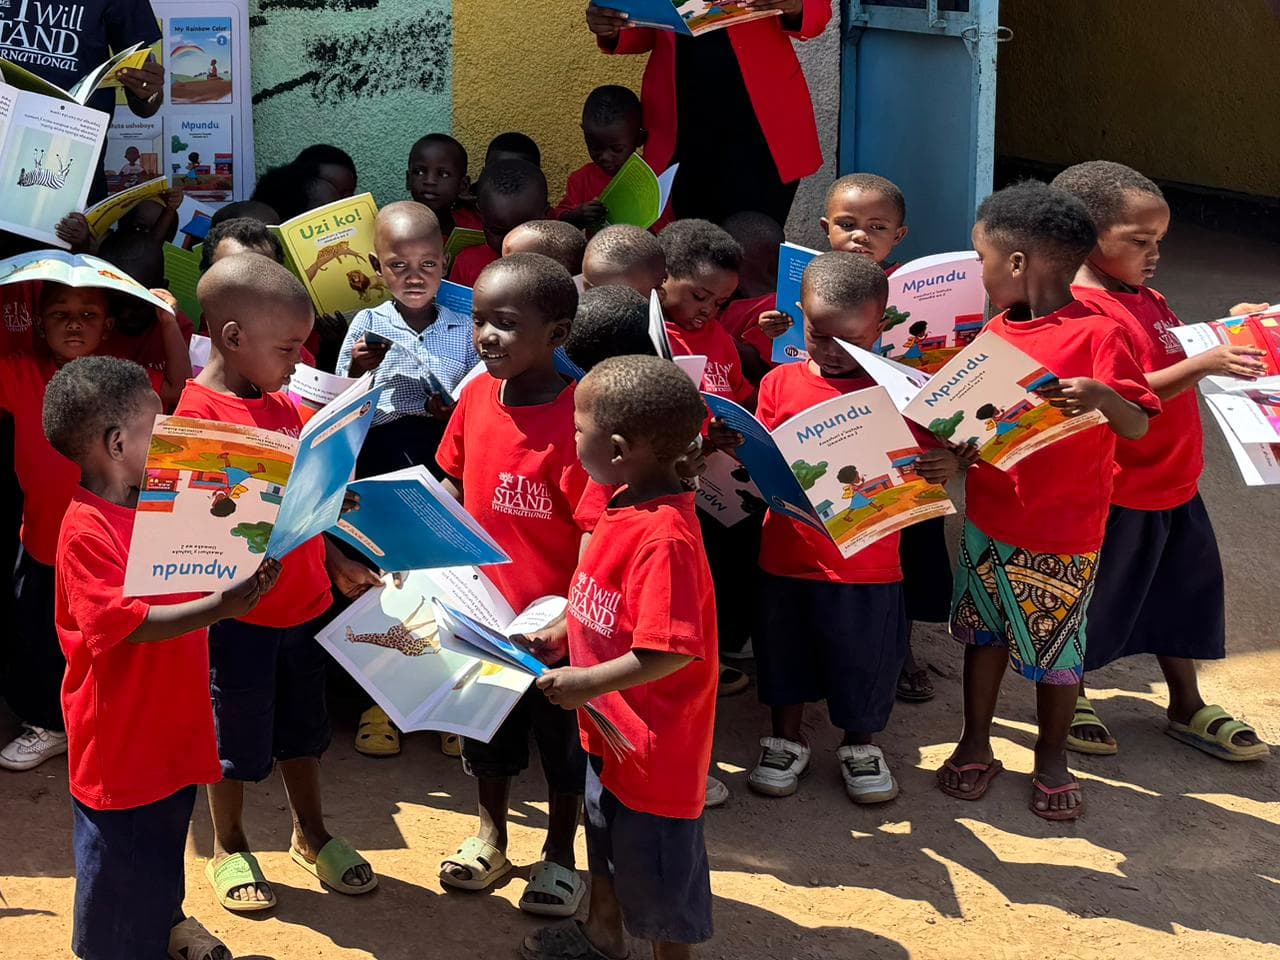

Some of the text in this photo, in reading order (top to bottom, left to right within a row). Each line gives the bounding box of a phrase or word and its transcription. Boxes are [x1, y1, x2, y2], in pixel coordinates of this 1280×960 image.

[33, 1, 84, 32] Will
[181, 120, 220, 132] Mpundu
[300, 219, 330, 240] Uzi
[333, 208, 362, 227] ko!
[902, 269, 966, 293] Mpundu
[924, 353, 989, 407] Mpundu
[796, 405, 872, 444] Mpundu
[493, 486, 552, 512] STAND
[515, 474, 526, 493] I
[152, 559, 237, 581] Mpundu
[569, 586, 615, 628] STAND
[583, 577, 622, 613] I Will
